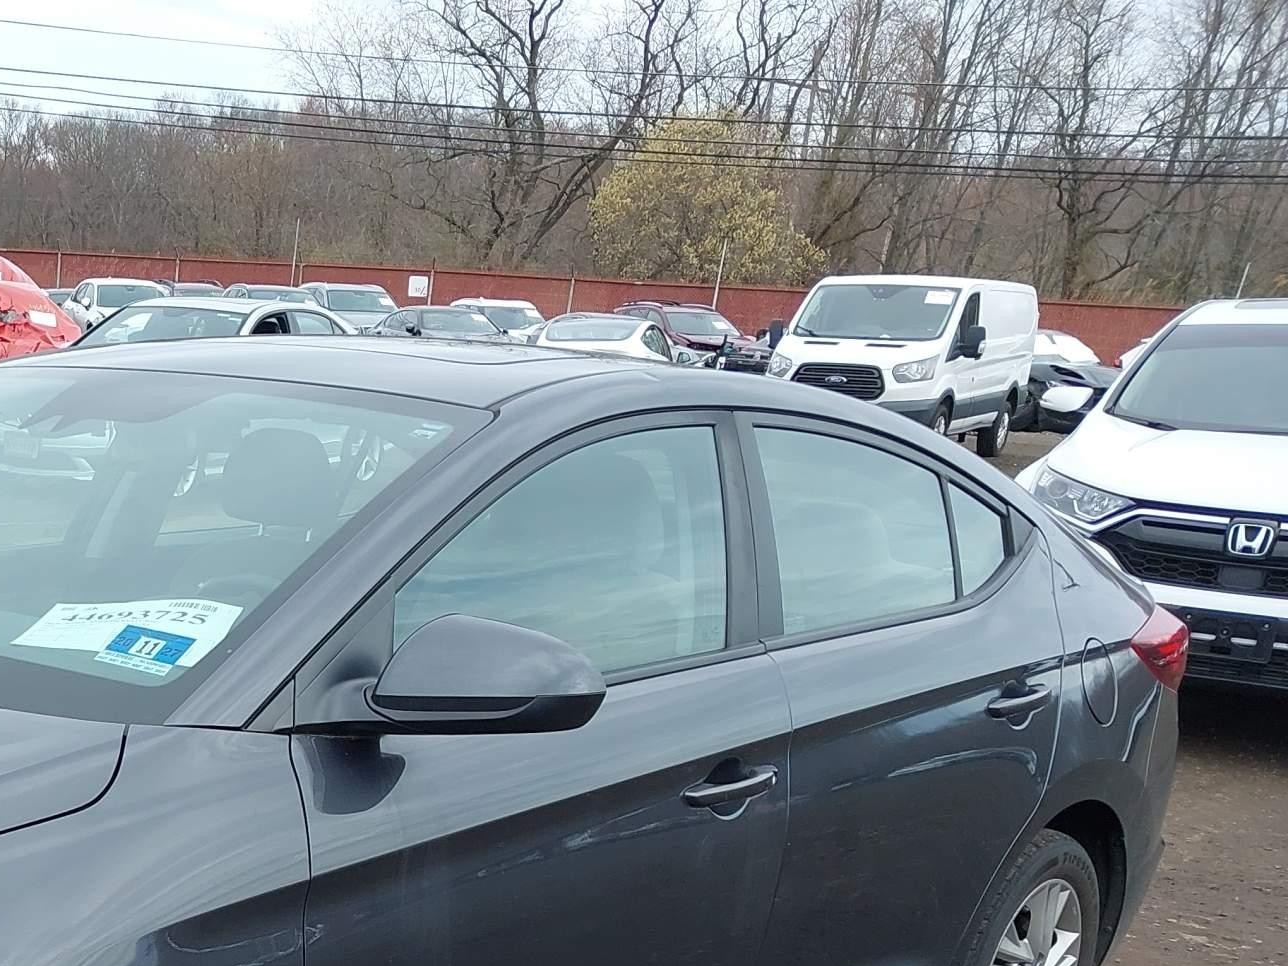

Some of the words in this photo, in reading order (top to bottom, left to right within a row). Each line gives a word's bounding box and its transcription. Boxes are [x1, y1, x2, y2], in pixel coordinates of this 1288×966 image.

[61, 610, 209, 625] 44693725
[135, 640, 161, 656] 11
[160, 647, 183, 657] 27
